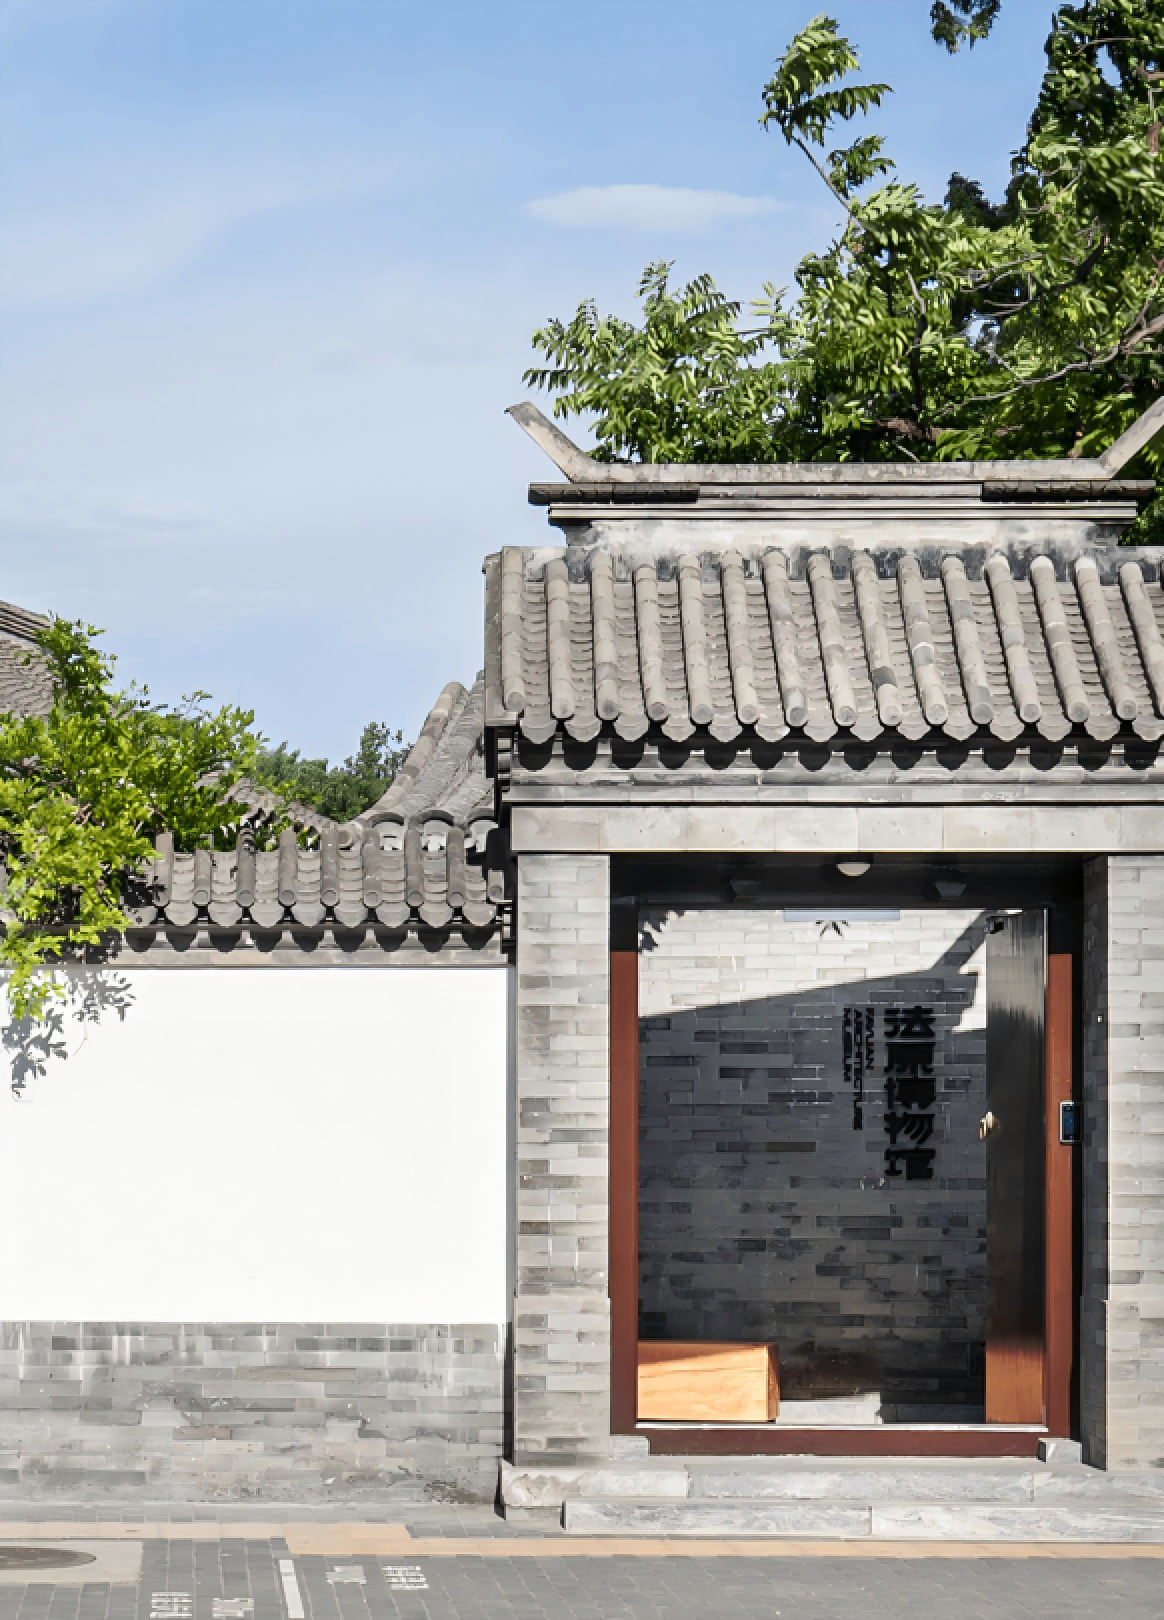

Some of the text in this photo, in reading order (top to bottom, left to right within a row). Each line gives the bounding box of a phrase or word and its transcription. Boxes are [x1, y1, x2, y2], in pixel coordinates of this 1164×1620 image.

[884, 1006, 936, 1180] 法原博物馆
